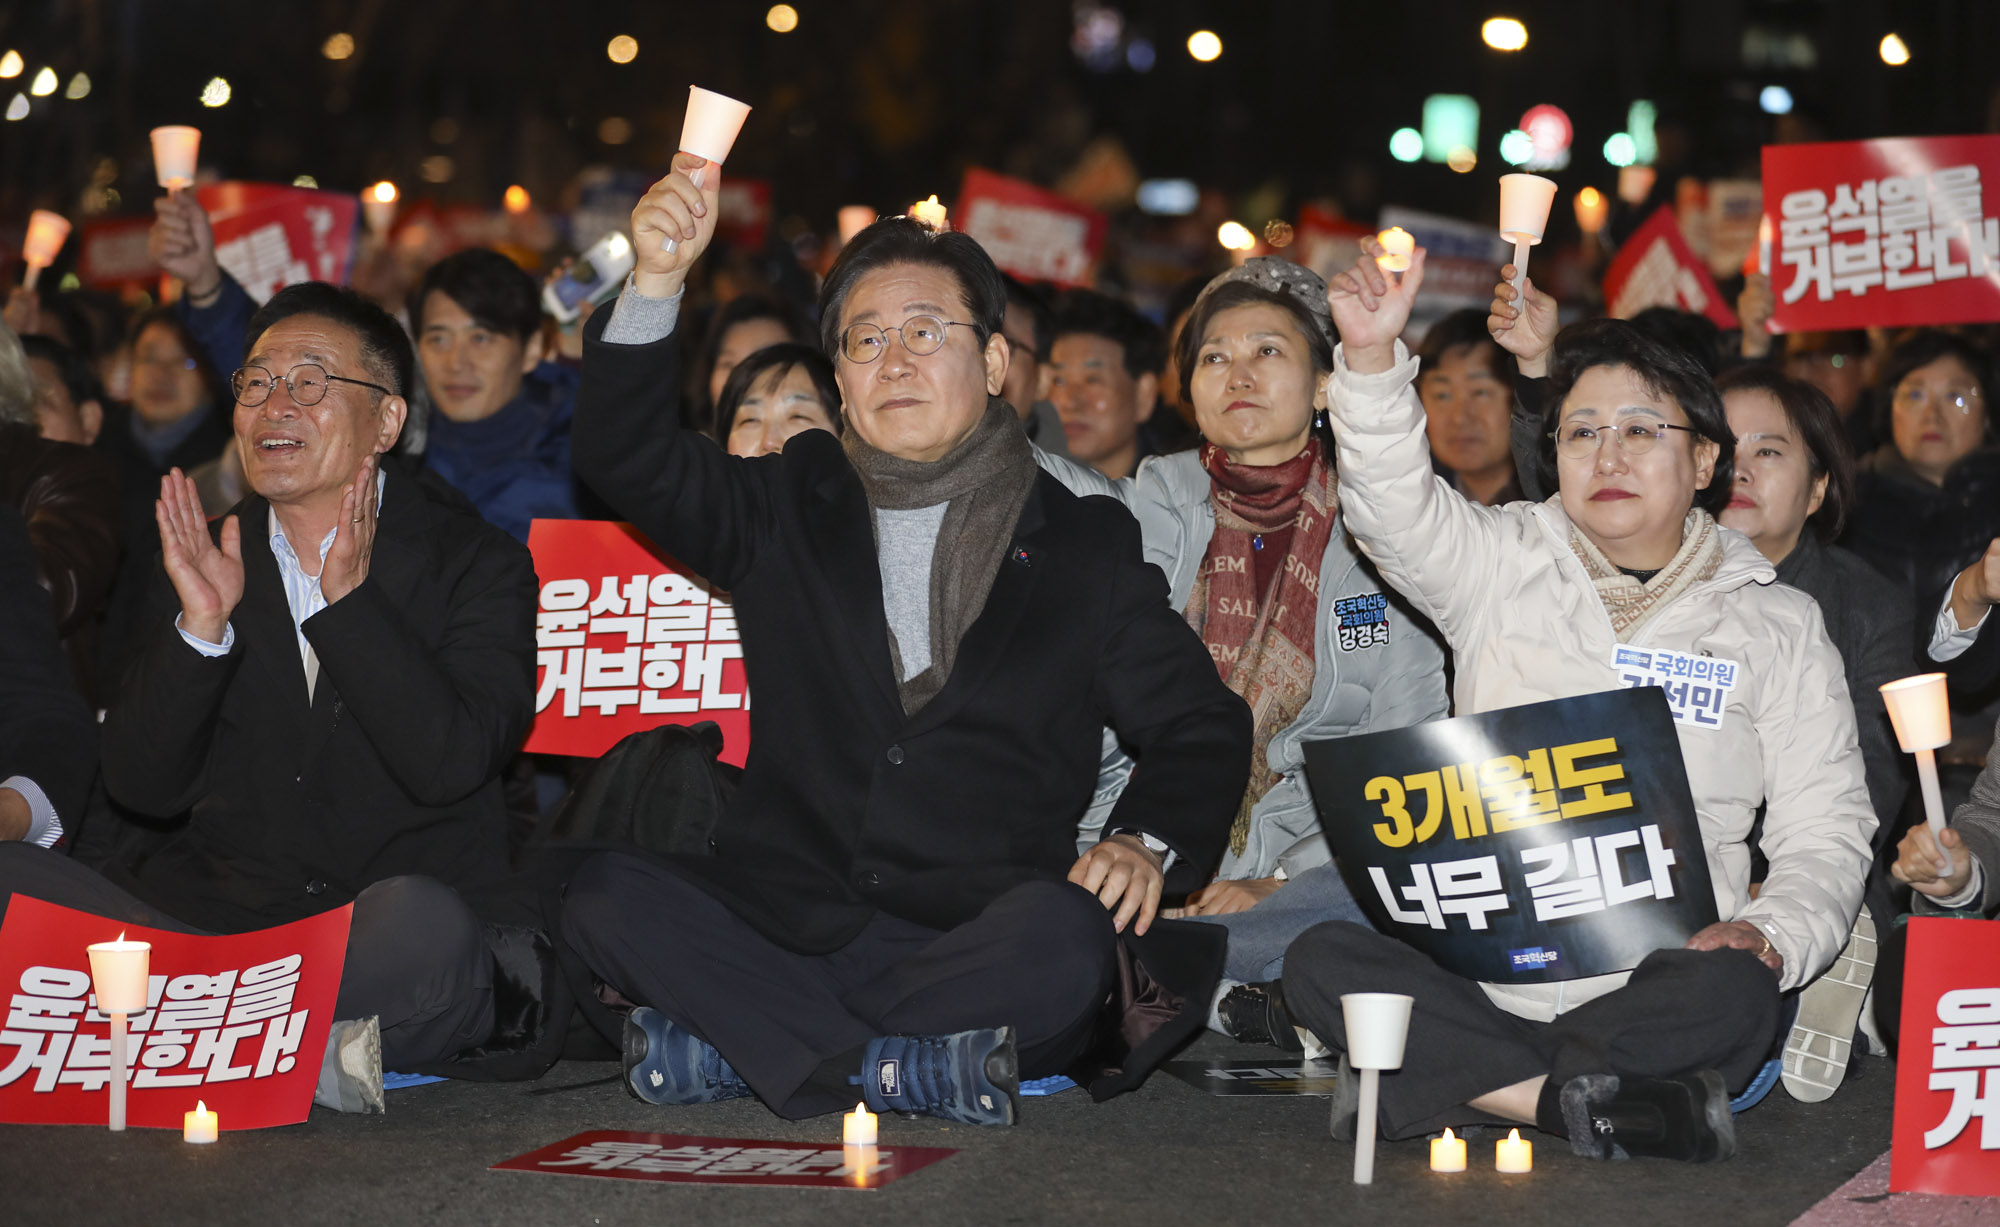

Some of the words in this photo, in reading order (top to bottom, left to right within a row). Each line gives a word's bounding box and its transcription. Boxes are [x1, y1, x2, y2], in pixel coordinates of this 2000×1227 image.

[1780, 164, 1983, 250] 윤석열을
[1336, 594, 1387, 616] 조국혁신당
[1343, 609, 1384, 627] 국회의원
[1340, 623, 1388, 650] 강경숙
[1656, 653, 1735, 687] 국회의원
[1364, 737, 1634, 848] 3개월도
[1367, 855, 1510, 930] 너무
[1520, 824, 1676, 922] 길다
[1513, 951, 1558, 964] 조국혁신당
[0, 1009, 309, 1092] 거부한다!
